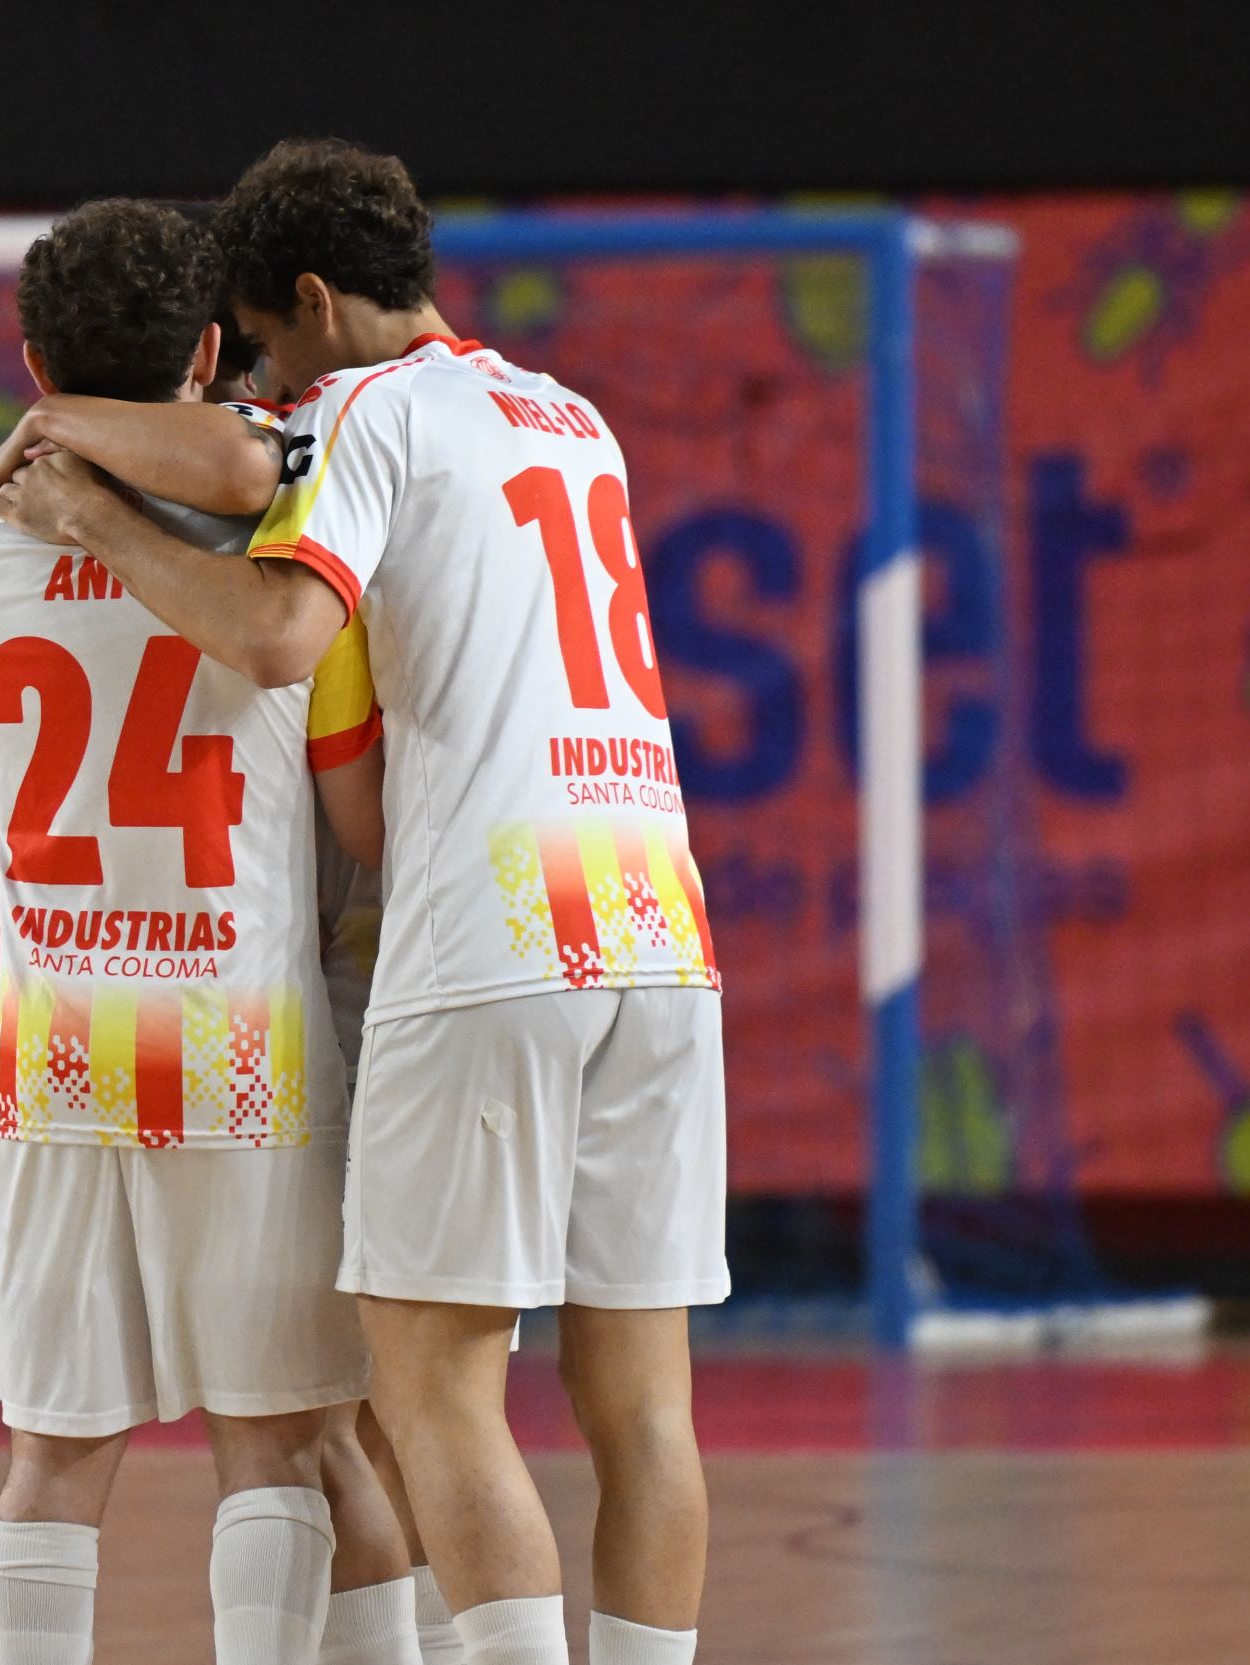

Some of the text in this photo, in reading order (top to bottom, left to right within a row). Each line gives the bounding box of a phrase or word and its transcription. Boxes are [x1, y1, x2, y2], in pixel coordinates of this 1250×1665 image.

[502, 466, 668, 721] 18
[549, 737, 680, 787] INDUSTRI
[567, 782, 635, 805] SANTA
[29, 947, 218, 978] ANTA COLOMA
